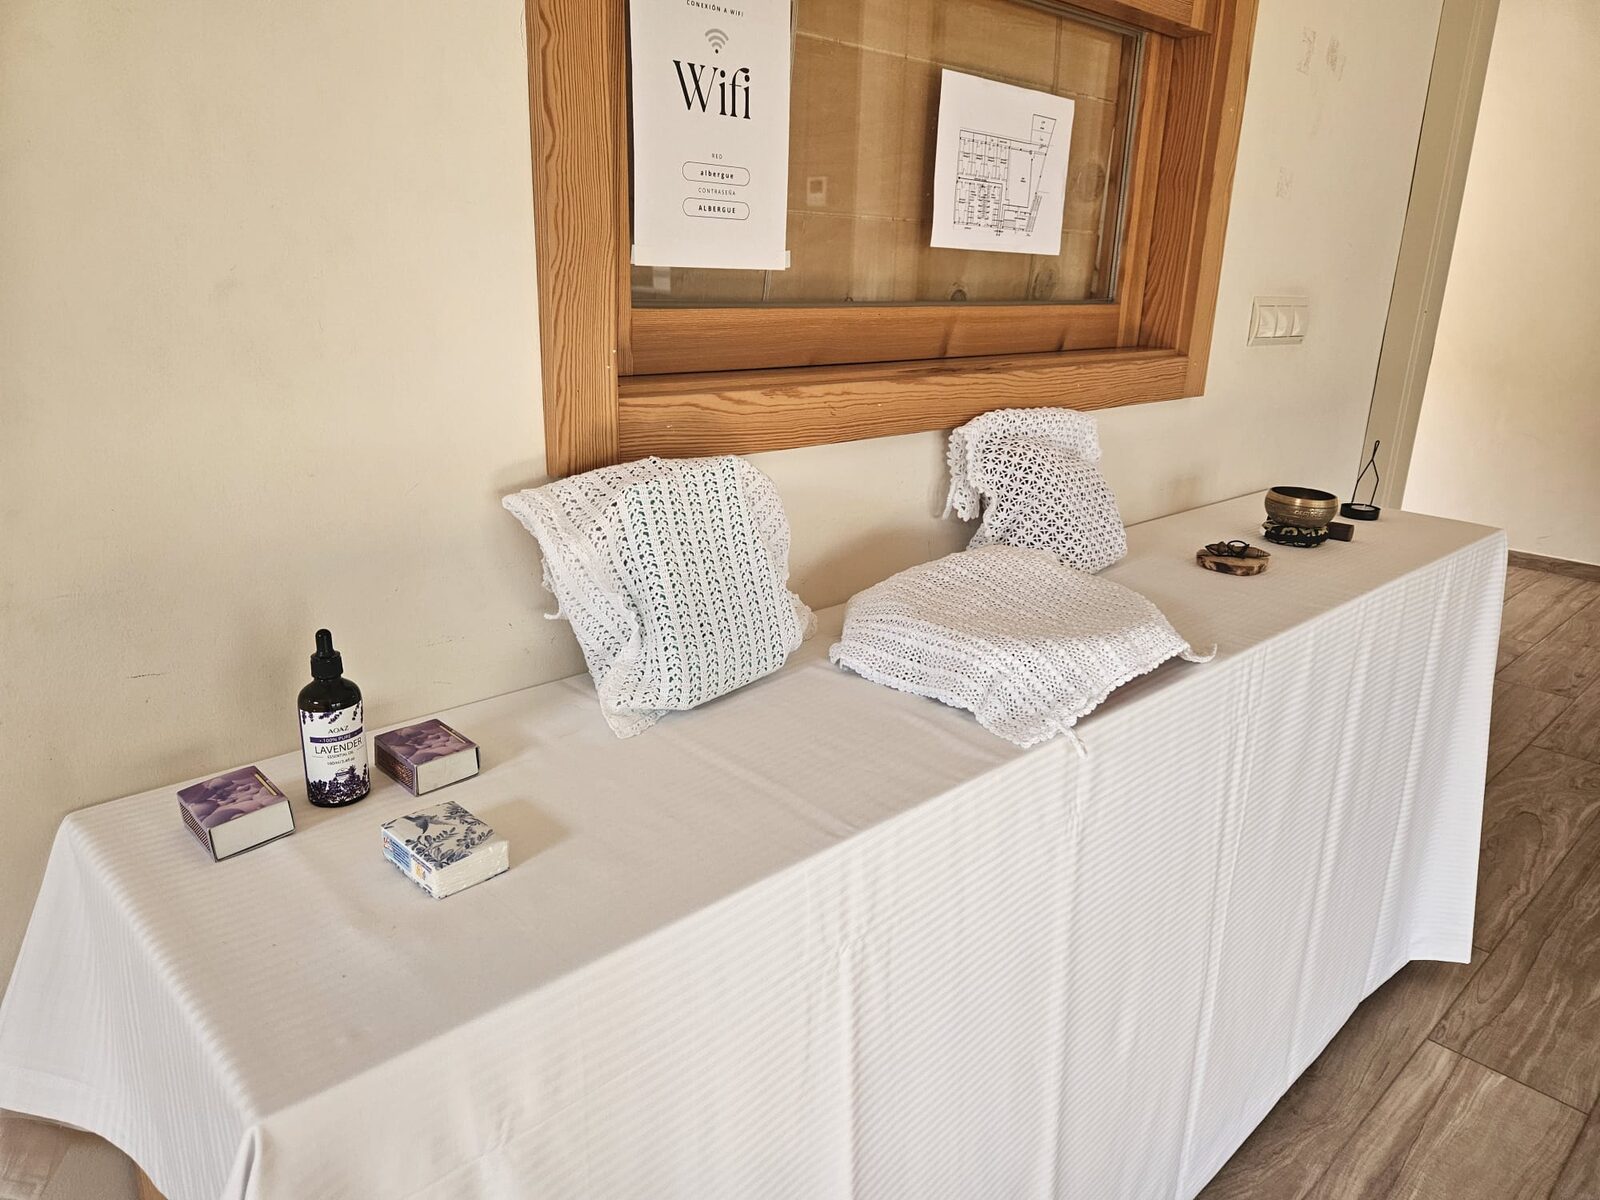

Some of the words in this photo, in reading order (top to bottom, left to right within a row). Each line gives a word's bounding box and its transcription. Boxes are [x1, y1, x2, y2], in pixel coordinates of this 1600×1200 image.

[672, 59, 751, 120] Wifi
[700, 169, 734, 180] albergue
[697, 187, 736, 196] CONTRASEÑA
[698, 204, 736, 214] ALBERGUE
[315, 737, 362, 754] LAVENDER
